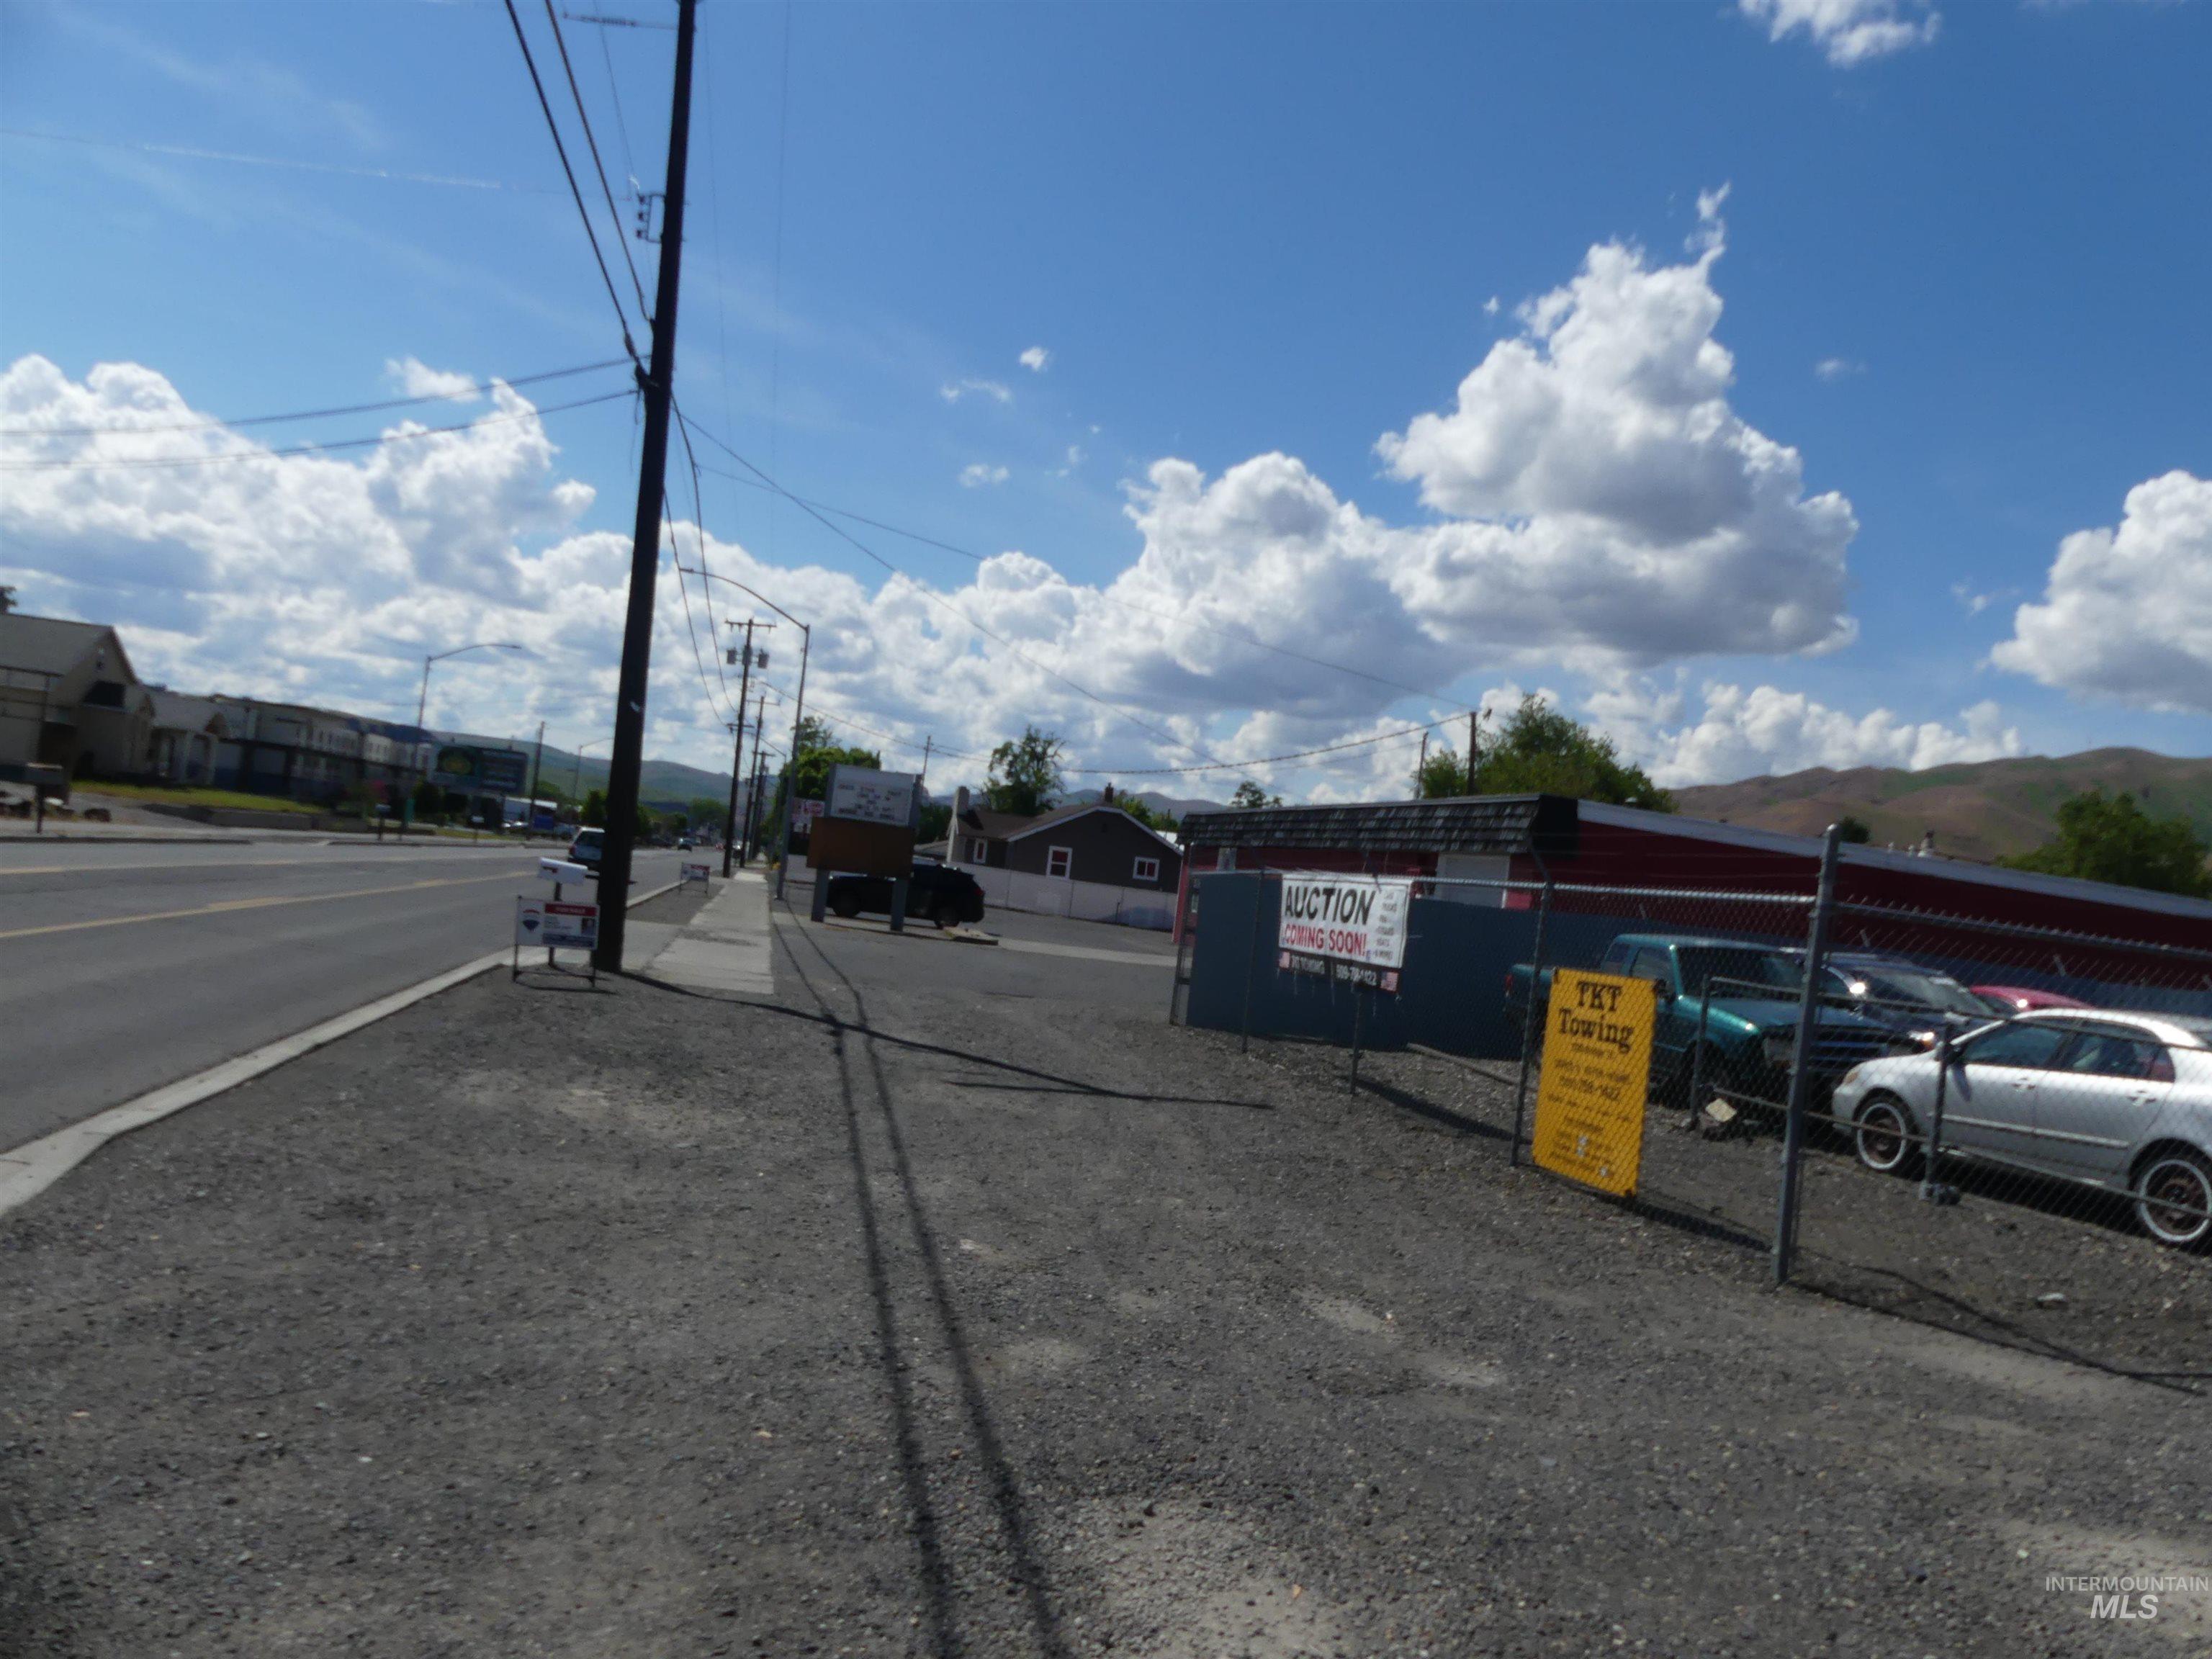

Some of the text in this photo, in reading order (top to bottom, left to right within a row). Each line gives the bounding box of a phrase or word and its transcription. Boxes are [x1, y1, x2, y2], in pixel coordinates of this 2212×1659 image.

[1285, 886, 1376, 925] AUCTION
[1284, 924, 1324, 949] COMING
[1328, 928, 1367, 957] SOON!
[1576, 980, 1622, 1012] TKT
[1558, 1008, 1635, 1054] Towing
